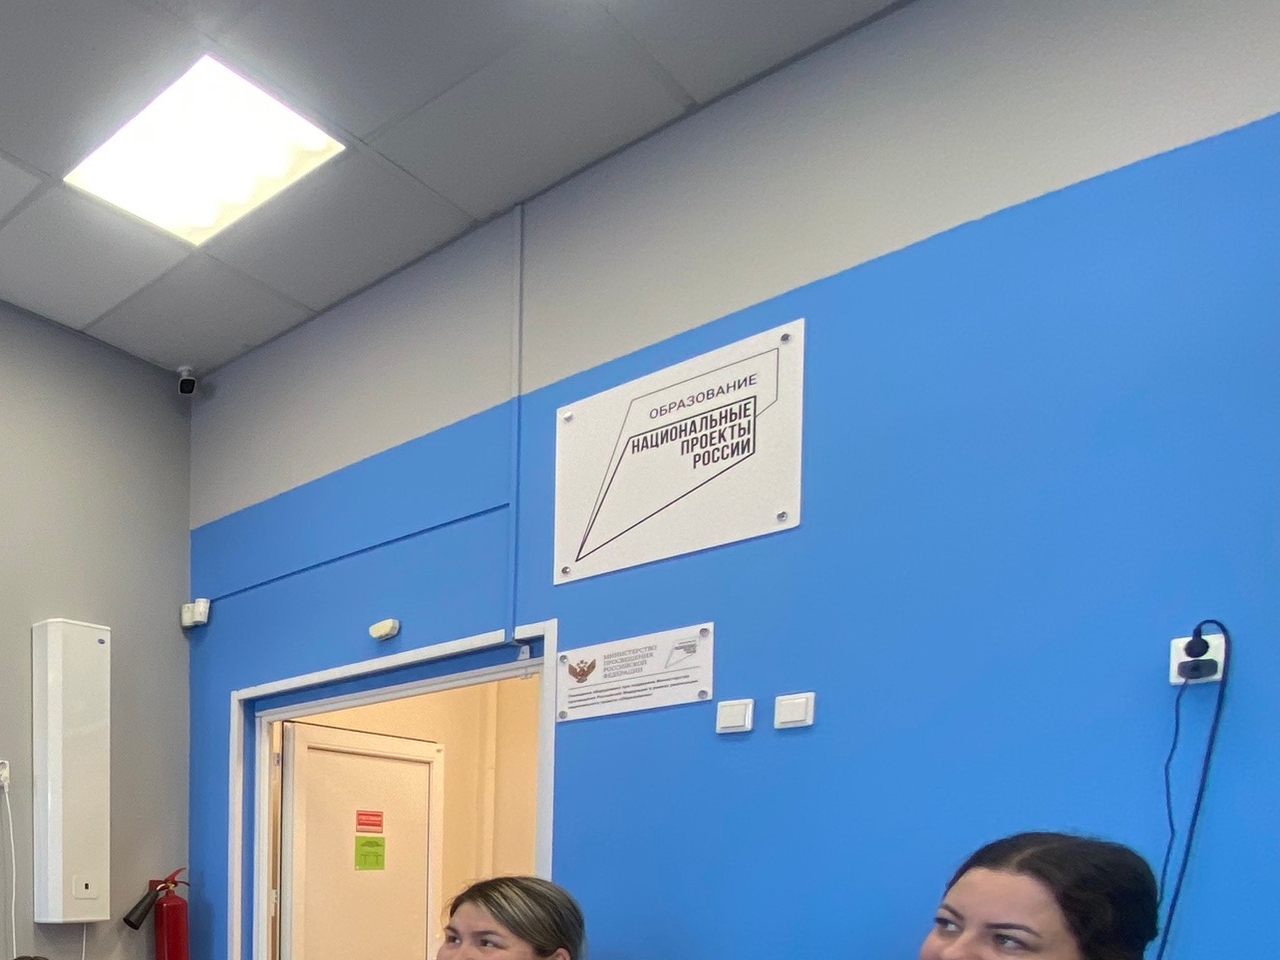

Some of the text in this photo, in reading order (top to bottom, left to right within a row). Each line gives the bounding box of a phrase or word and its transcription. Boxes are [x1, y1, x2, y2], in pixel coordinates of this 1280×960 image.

[649, 373, 757, 420] ОБРАЗОВАНИЕ
[631, 400, 752, 455] НАЦИОНАЛЬНЫЕ
[680, 419, 752, 456] ПРОЕКТЫ
[693, 438, 752, 469] РОССИИ
